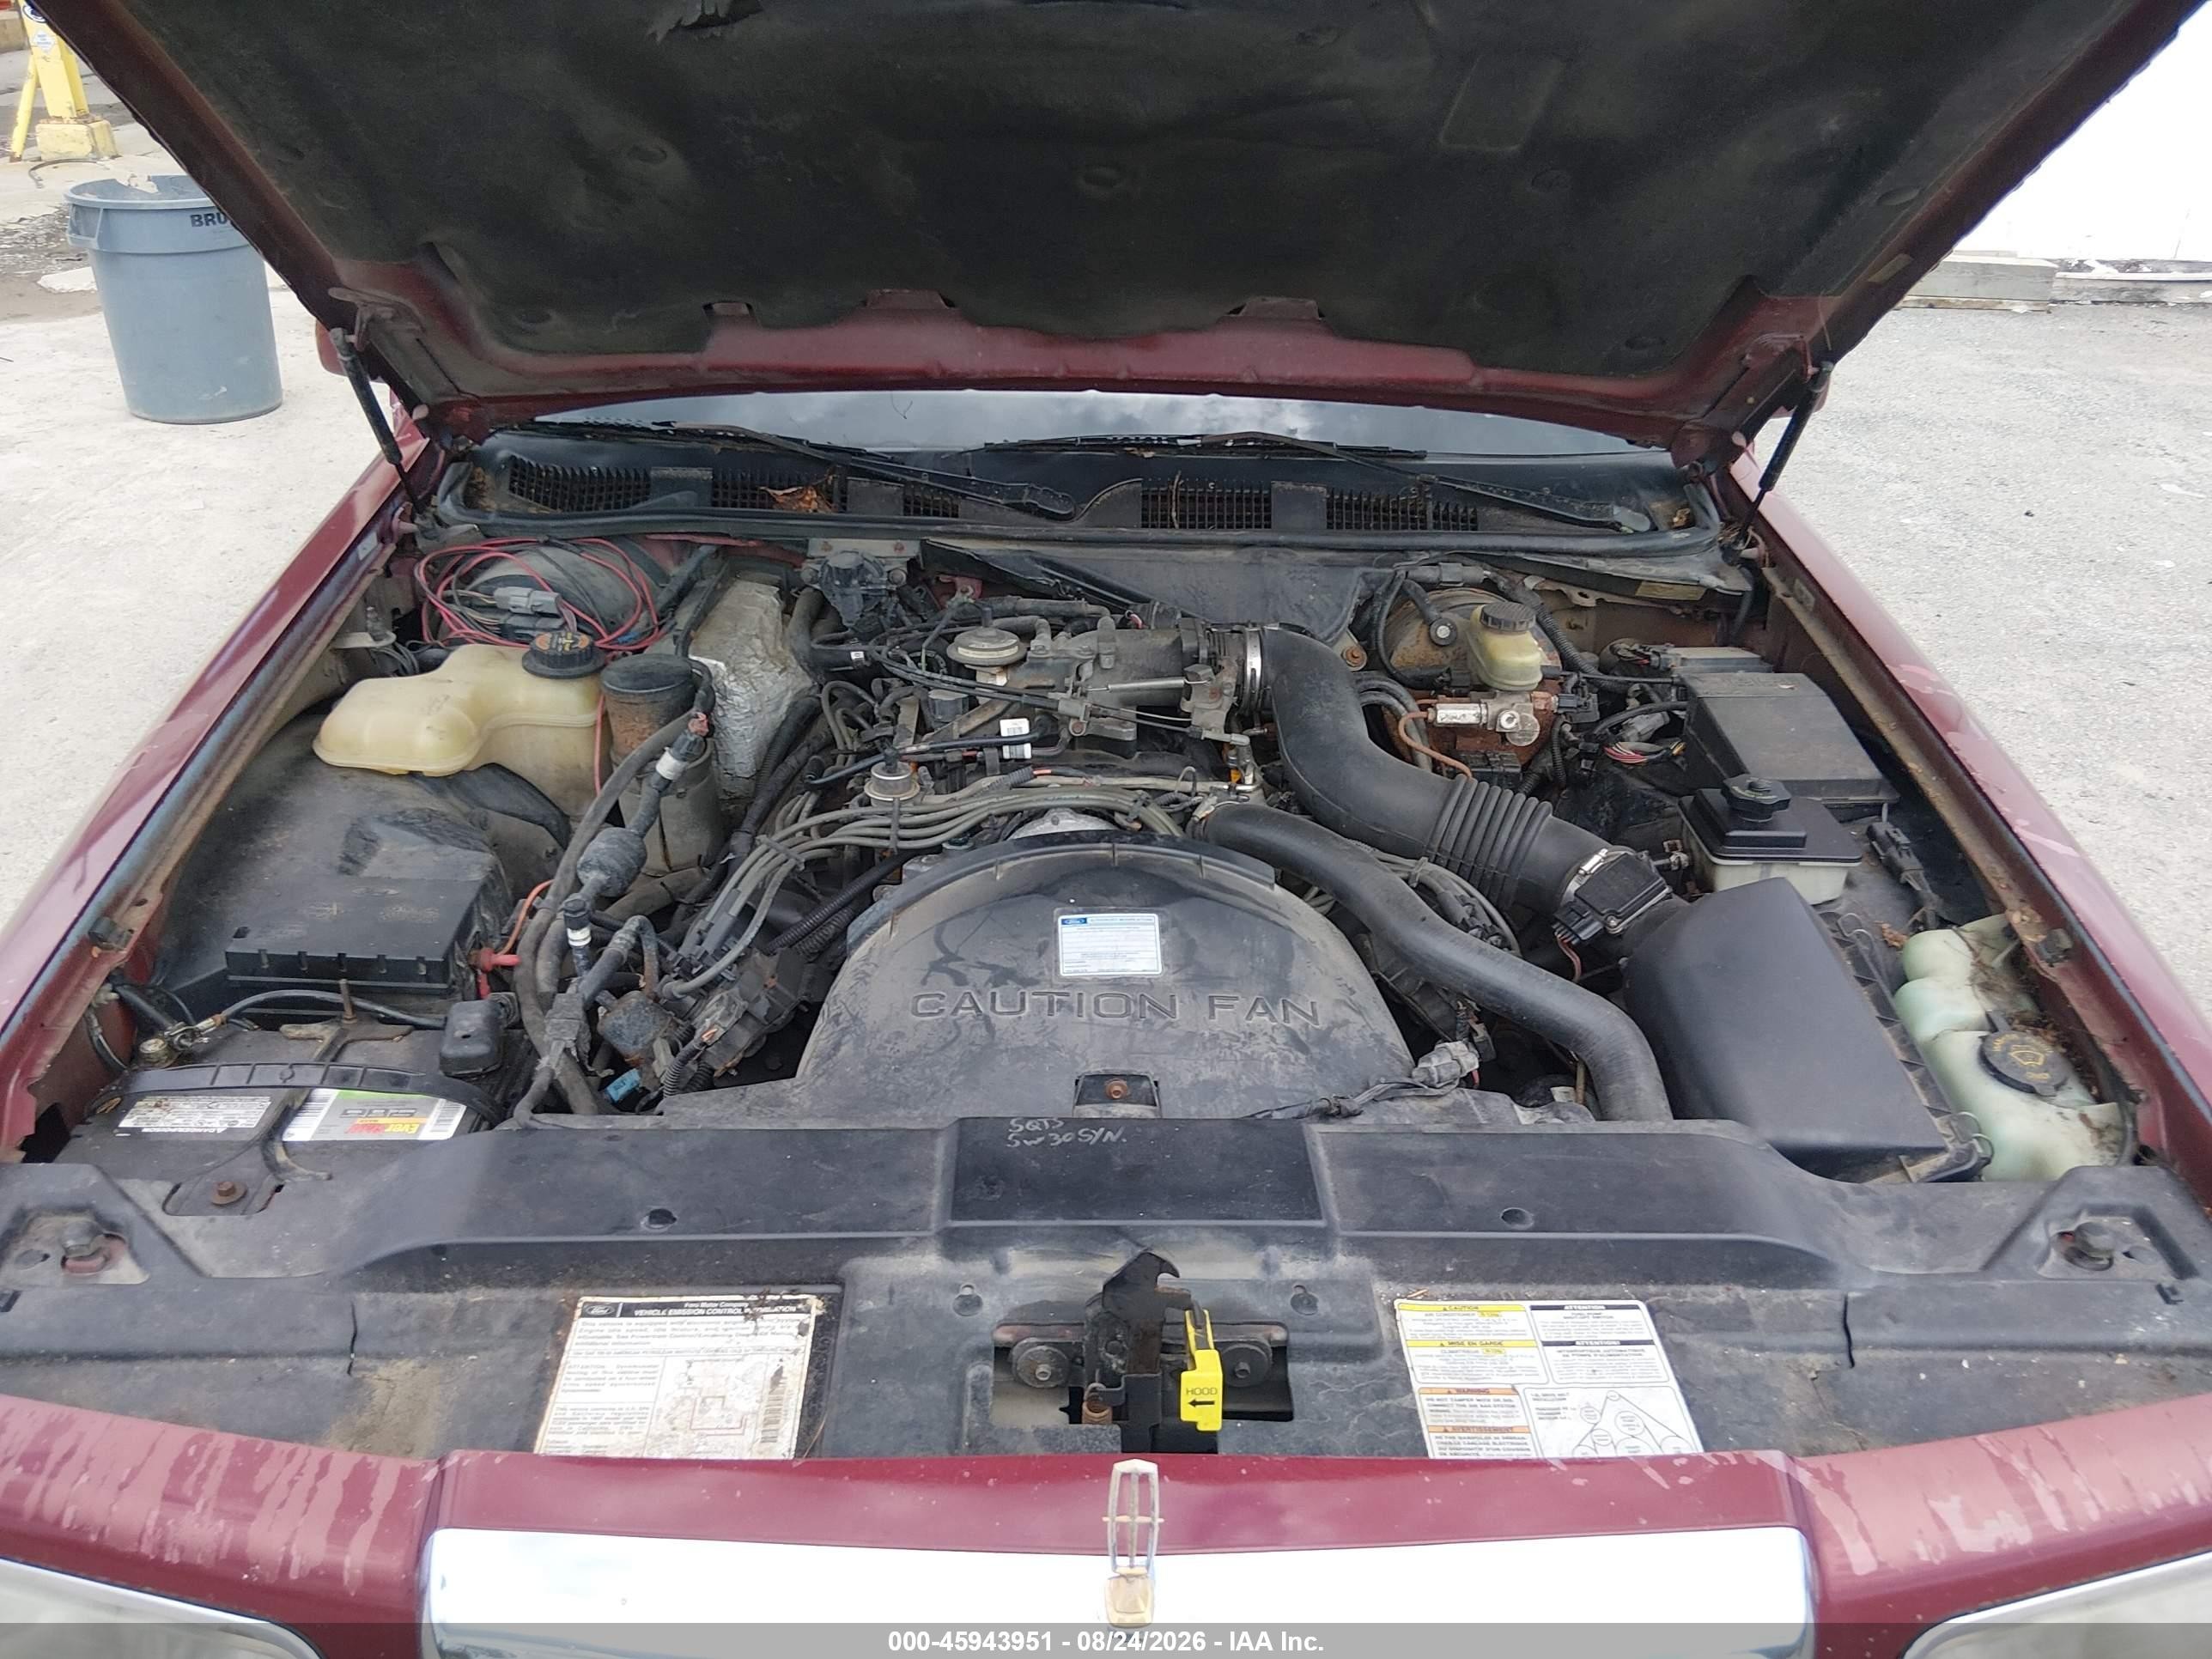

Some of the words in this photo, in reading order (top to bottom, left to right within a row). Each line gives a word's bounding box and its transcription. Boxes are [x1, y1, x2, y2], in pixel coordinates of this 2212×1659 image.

[910, 991, 1178, 1018] CAUTION
[1207, 994, 1321, 1027] FAN
[1185, 1387, 1218, 1395] HOOD
